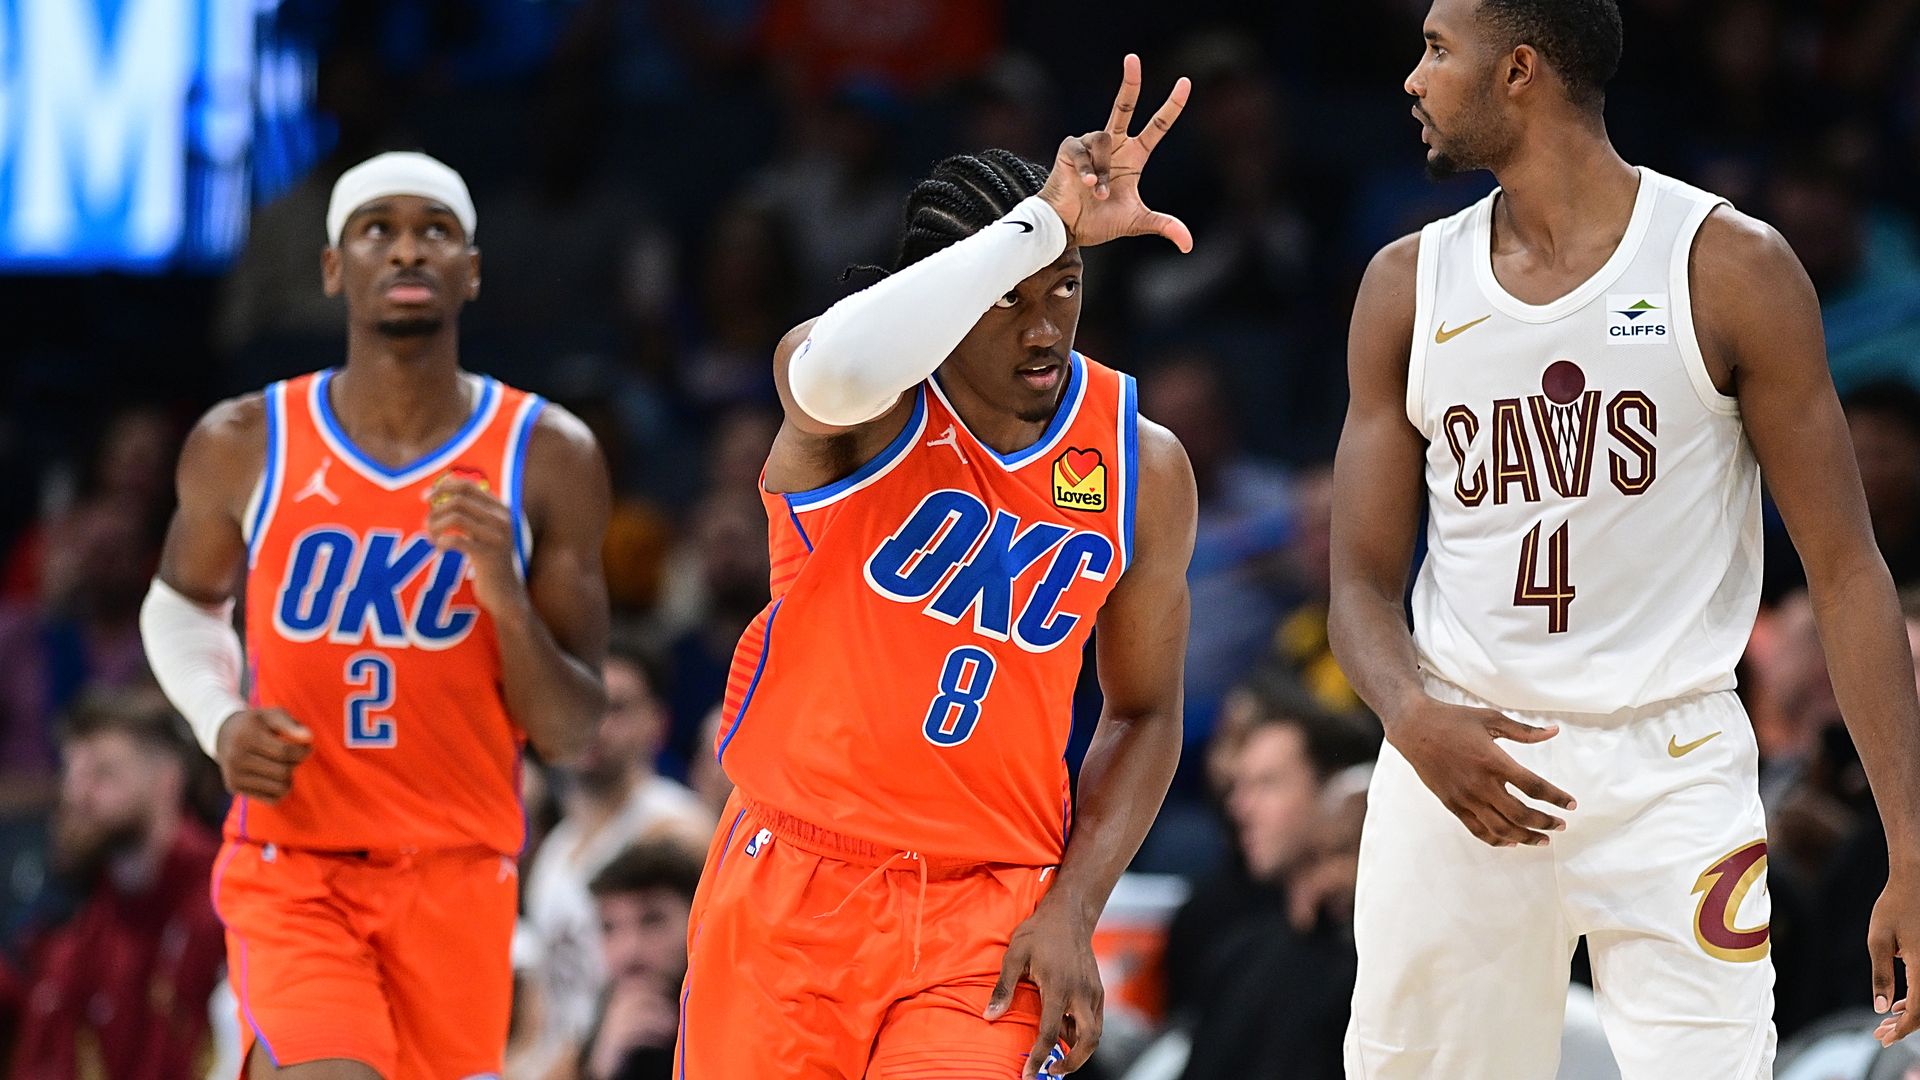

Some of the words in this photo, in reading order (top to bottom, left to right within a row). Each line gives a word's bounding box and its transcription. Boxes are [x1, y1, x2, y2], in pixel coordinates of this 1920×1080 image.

[1609, 325, 1666, 337] CLIFFS
[1443, 390, 1657, 508] CAVS
[273, 523, 480, 650] OKC
[863, 488, 1114, 653] OKC
[1513, 519, 1576, 634] 4
[344, 651, 396, 749] 2
[922, 645, 997, 747] 8
